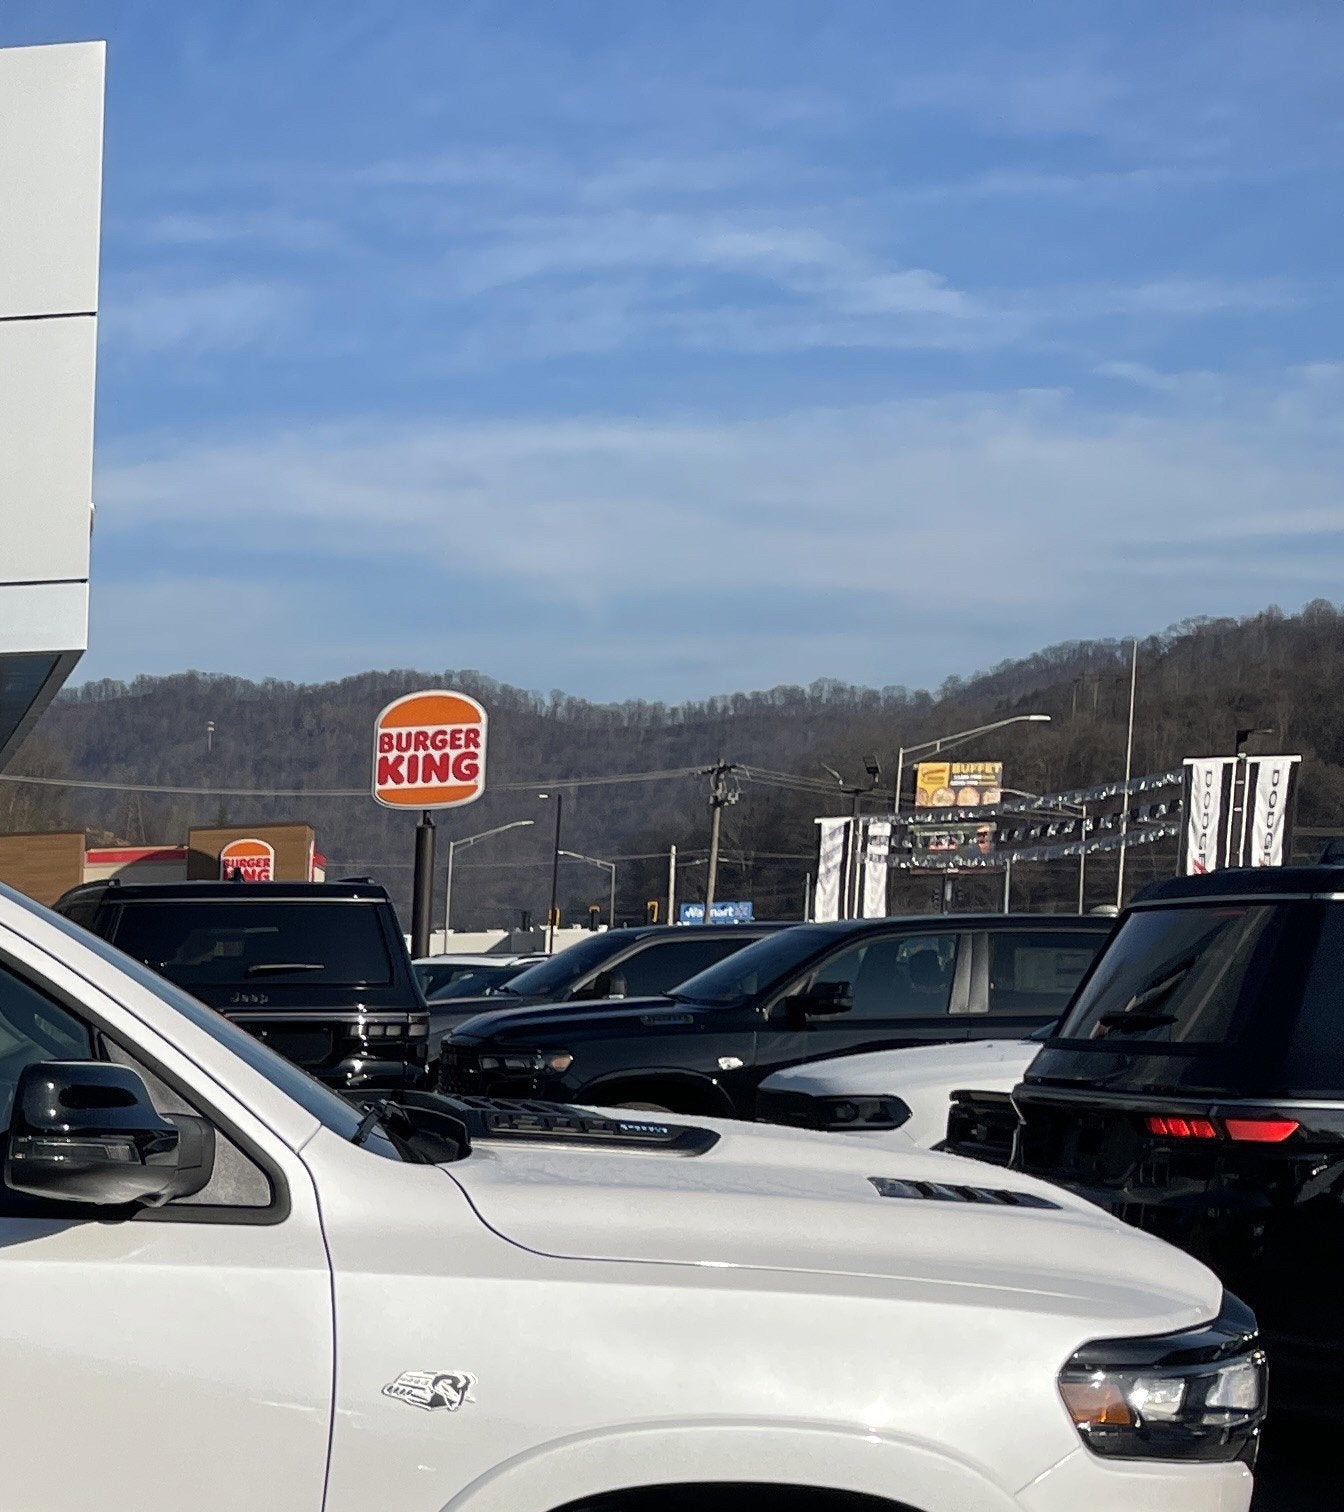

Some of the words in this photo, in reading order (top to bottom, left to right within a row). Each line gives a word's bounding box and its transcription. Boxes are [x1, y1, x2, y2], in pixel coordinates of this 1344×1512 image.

[379, 728, 481, 753] BURGER
[377, 751, 480, 785] KING
[952, 762, 1000, 774] BUFFET
[1199, 770, 1213, 868] DODGE
[223, 858, 271, 868] BURGER
[685, 906, 734, 918] Wamart
